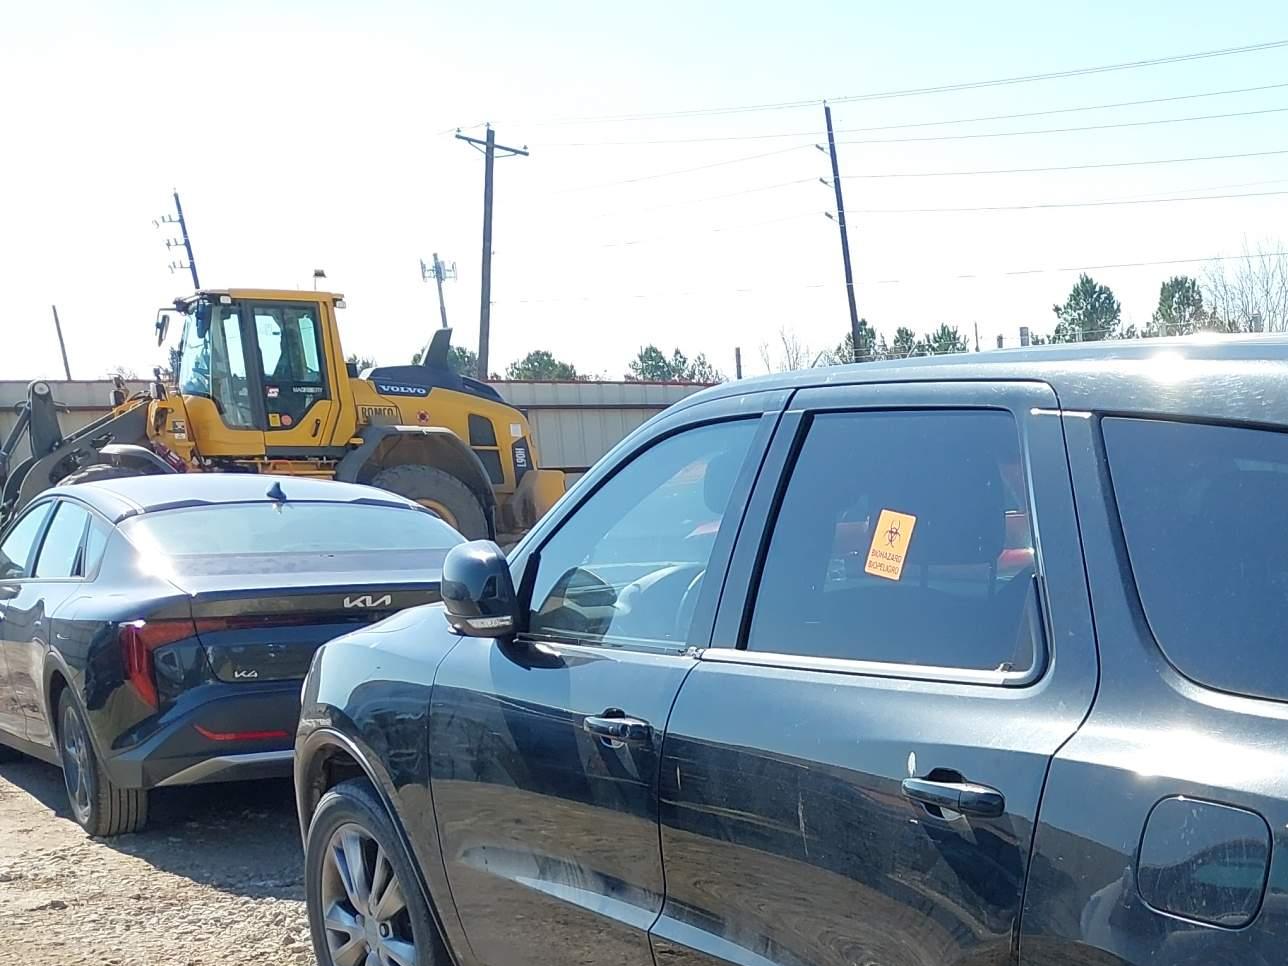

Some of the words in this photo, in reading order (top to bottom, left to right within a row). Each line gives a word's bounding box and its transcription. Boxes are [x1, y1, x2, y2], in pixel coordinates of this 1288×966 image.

[379, 385, 427, 394] VOLVO
[871, 549, 902, 563] BIOHAZARD
[867, 560, 900, 575] BIOPELIGRO
[344, 595, 392, 608] KIA
[234, 669, 258, 679] K4
